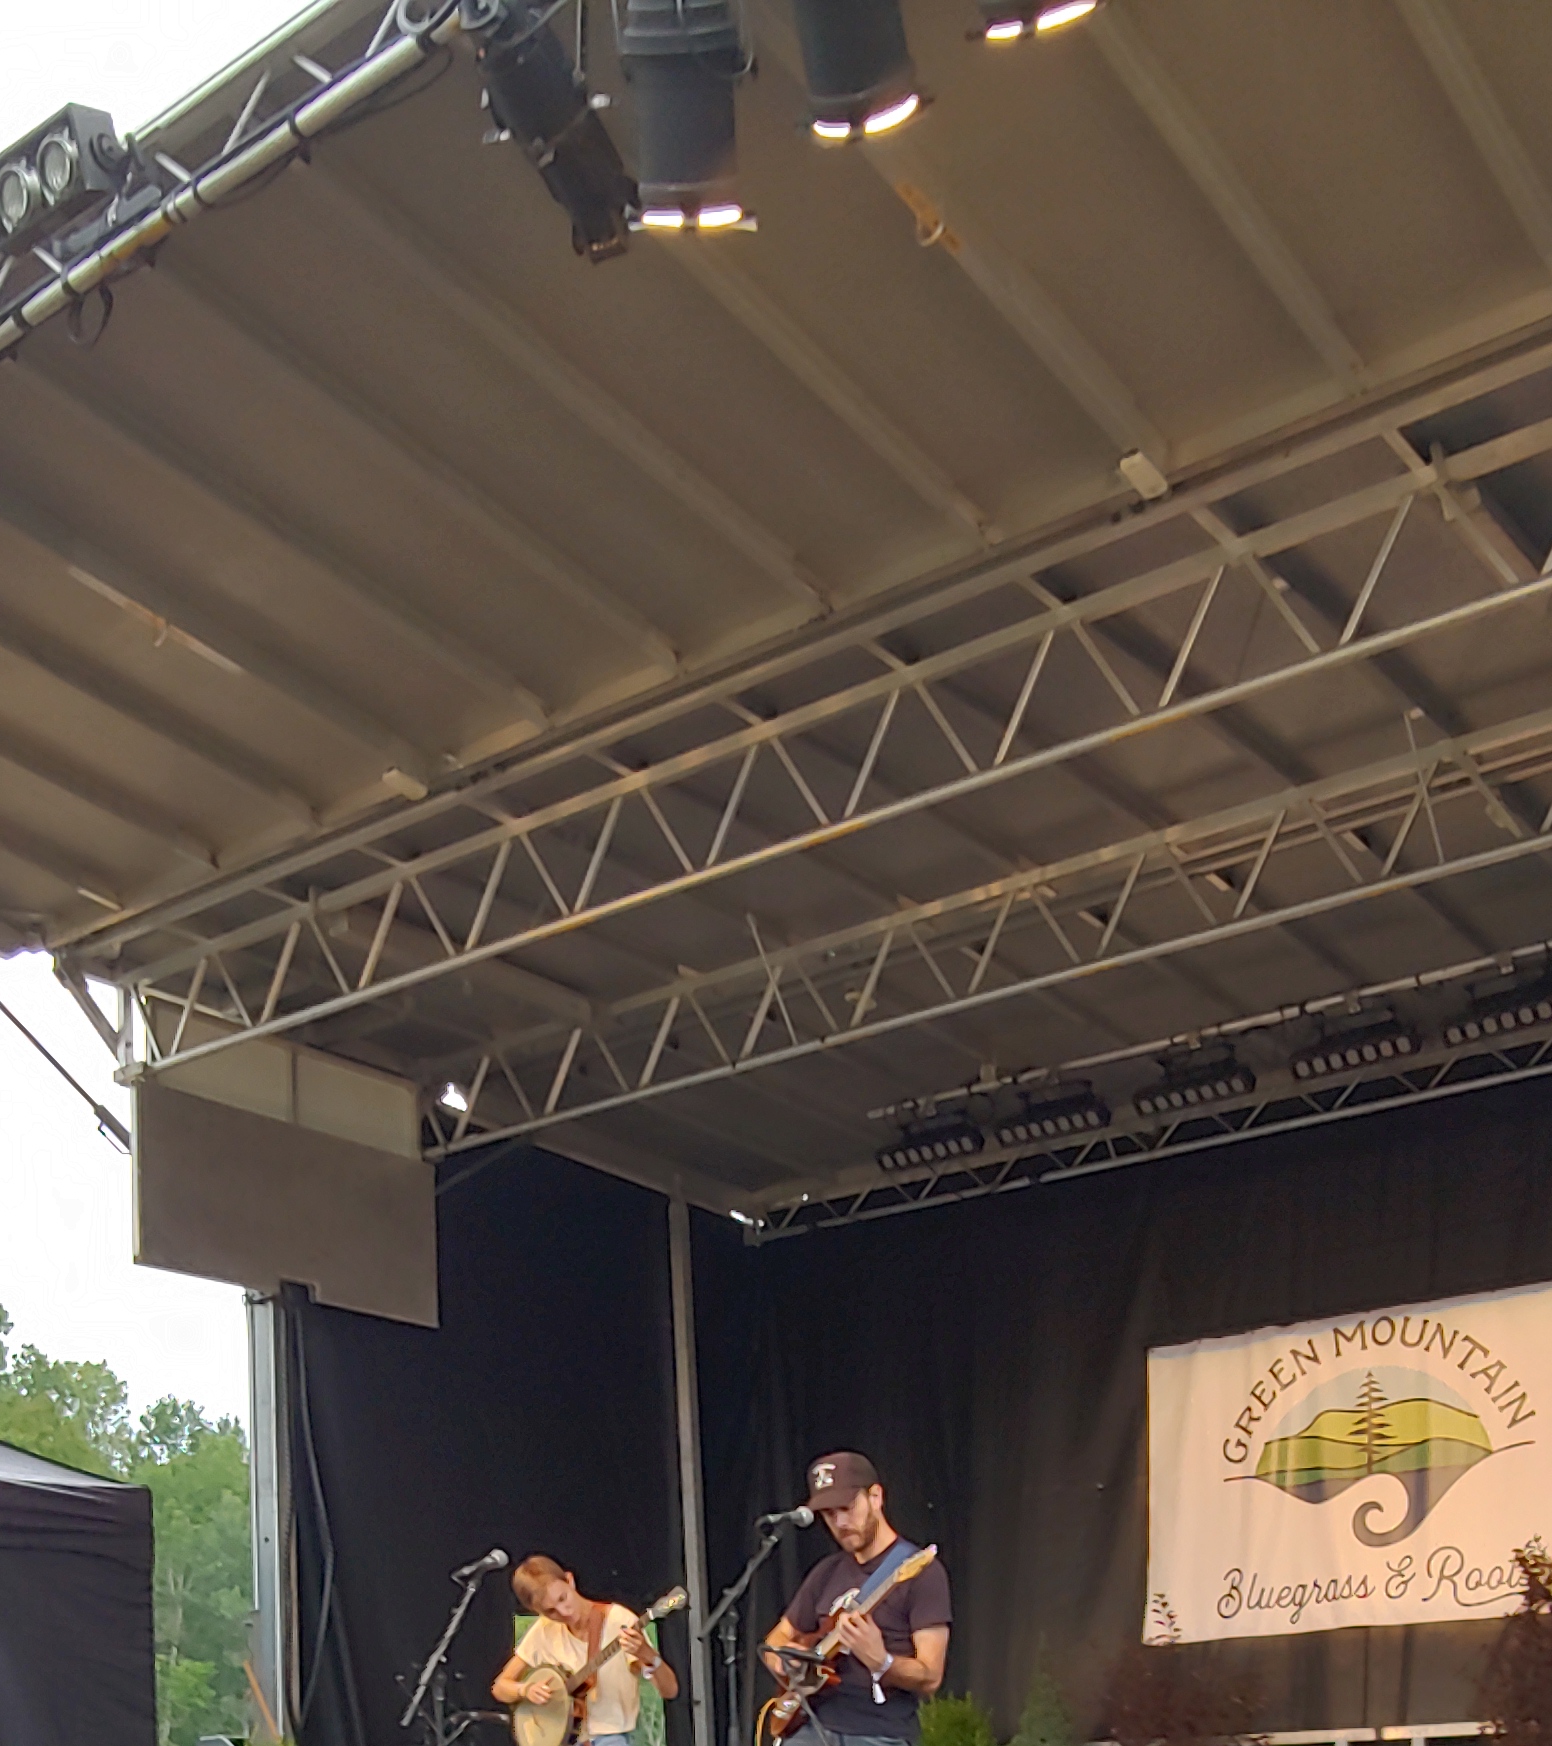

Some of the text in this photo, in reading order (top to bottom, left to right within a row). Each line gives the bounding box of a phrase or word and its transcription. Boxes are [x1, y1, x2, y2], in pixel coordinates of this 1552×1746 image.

[1222, 1315, 1537, 1464] GREEN MOUNTAIN
[1216, 1567, 1376, 1625] Bluegrass
[1384, 1555, 1416, 1600] &
